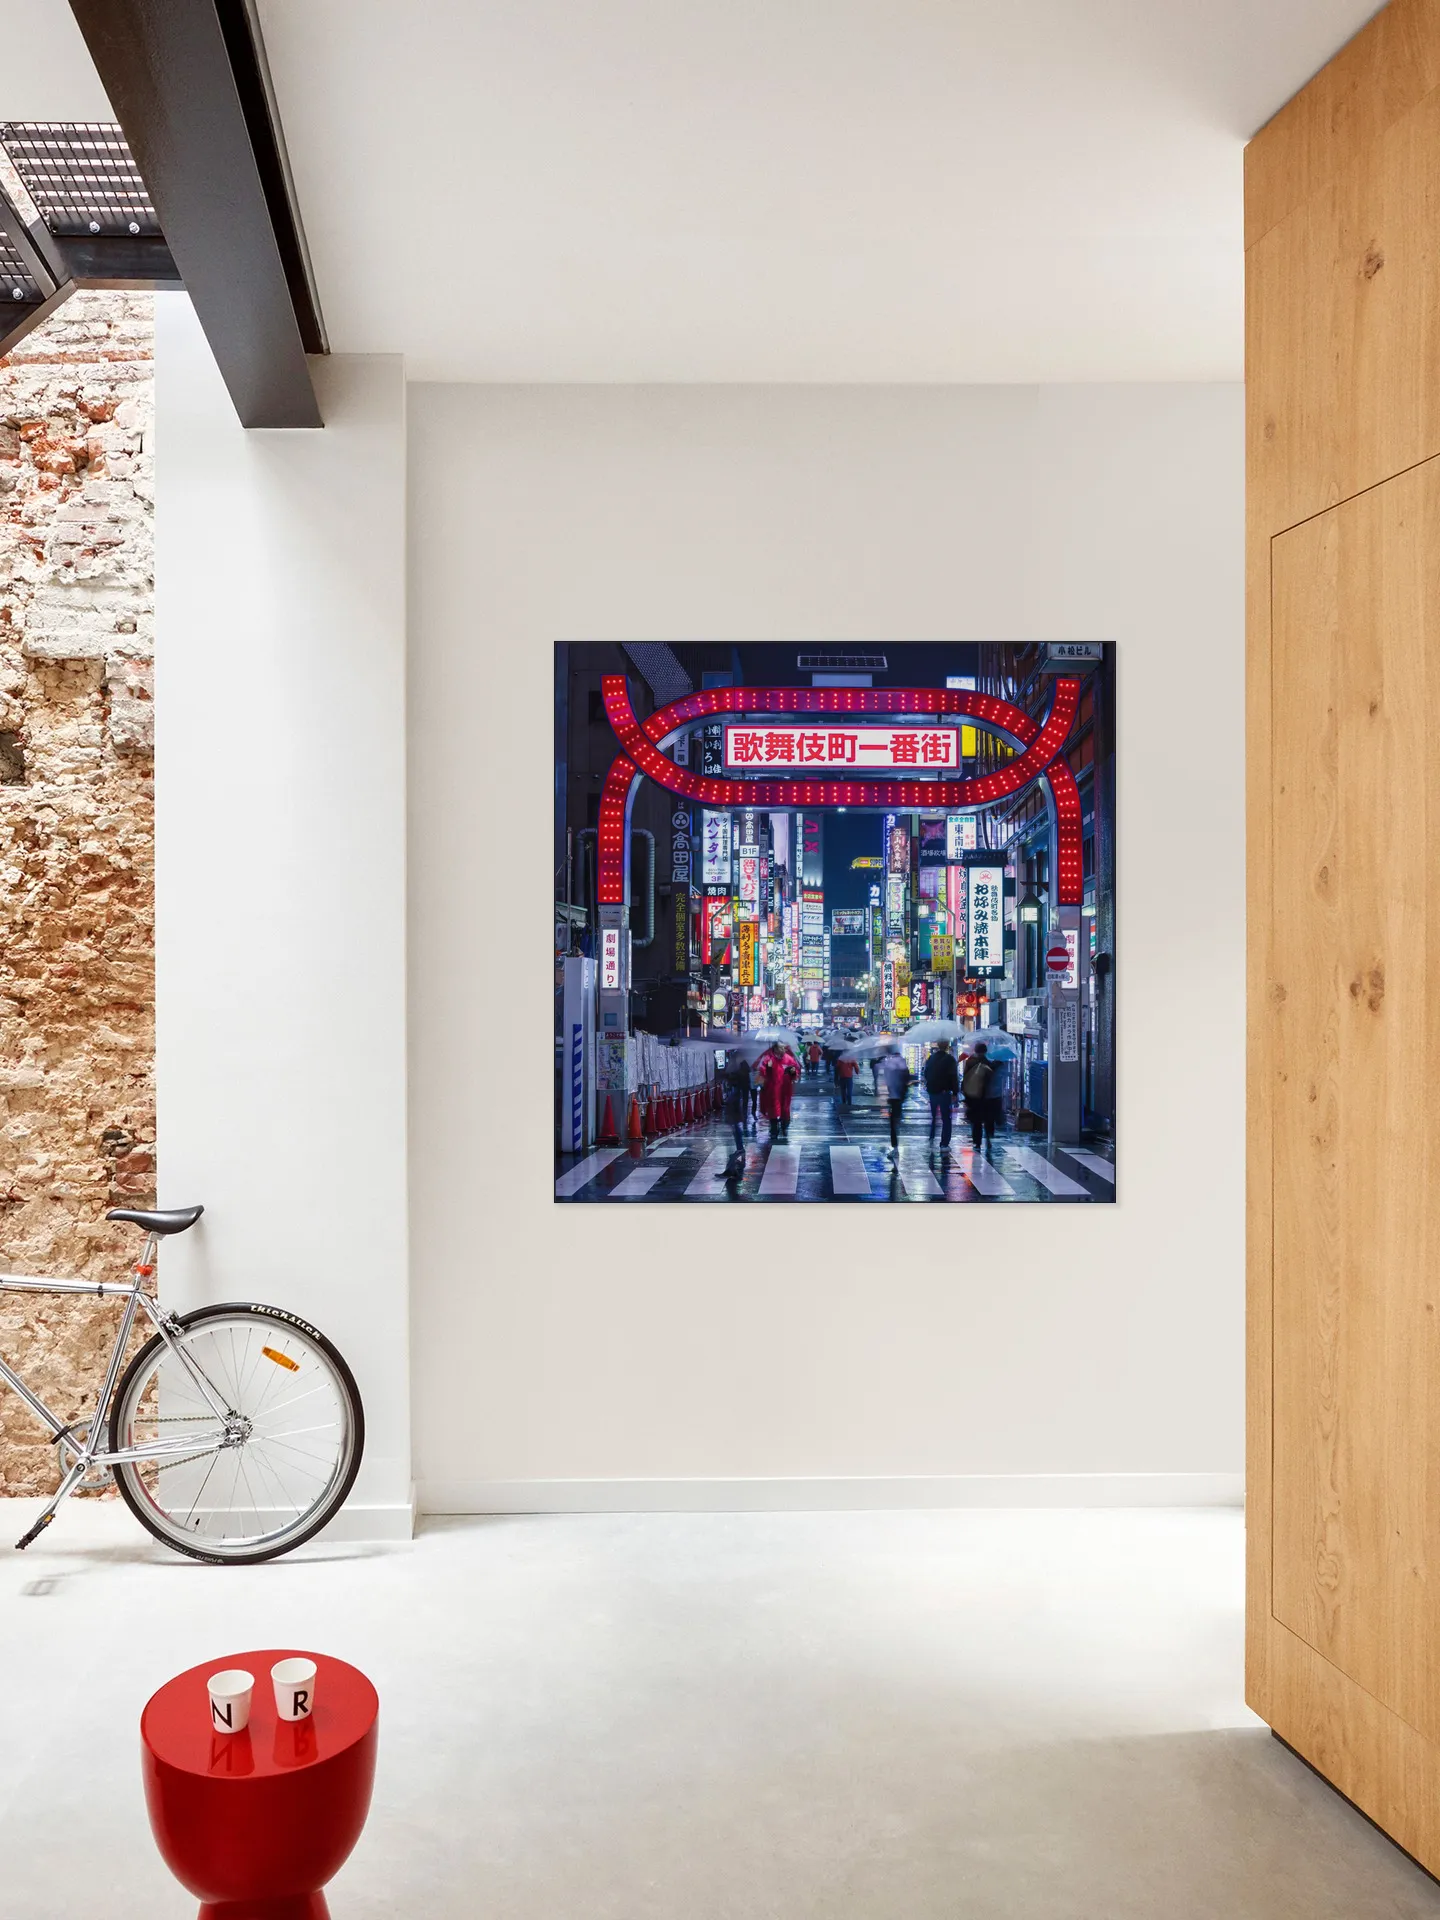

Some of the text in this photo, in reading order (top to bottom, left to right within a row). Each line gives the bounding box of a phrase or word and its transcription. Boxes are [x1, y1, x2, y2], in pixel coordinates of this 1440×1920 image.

[1058, 645, 1092, 656] 小松ビル
[733, 732, 951, 763] 歌舞伎町一番街
[672, 831, 690, 882] 高田屋
[742, 847, 757, 855] B1F
[974, 883, 989, 961] お好み焼本陣
[605, 933, 616, 984] 劇場通り
[977, 966, 992, 975] 2F
[884, 963, 893, 1008] 無料案内所
[211, 1699, 232, 1729] N
[293, 1690, 309, 1716] R
